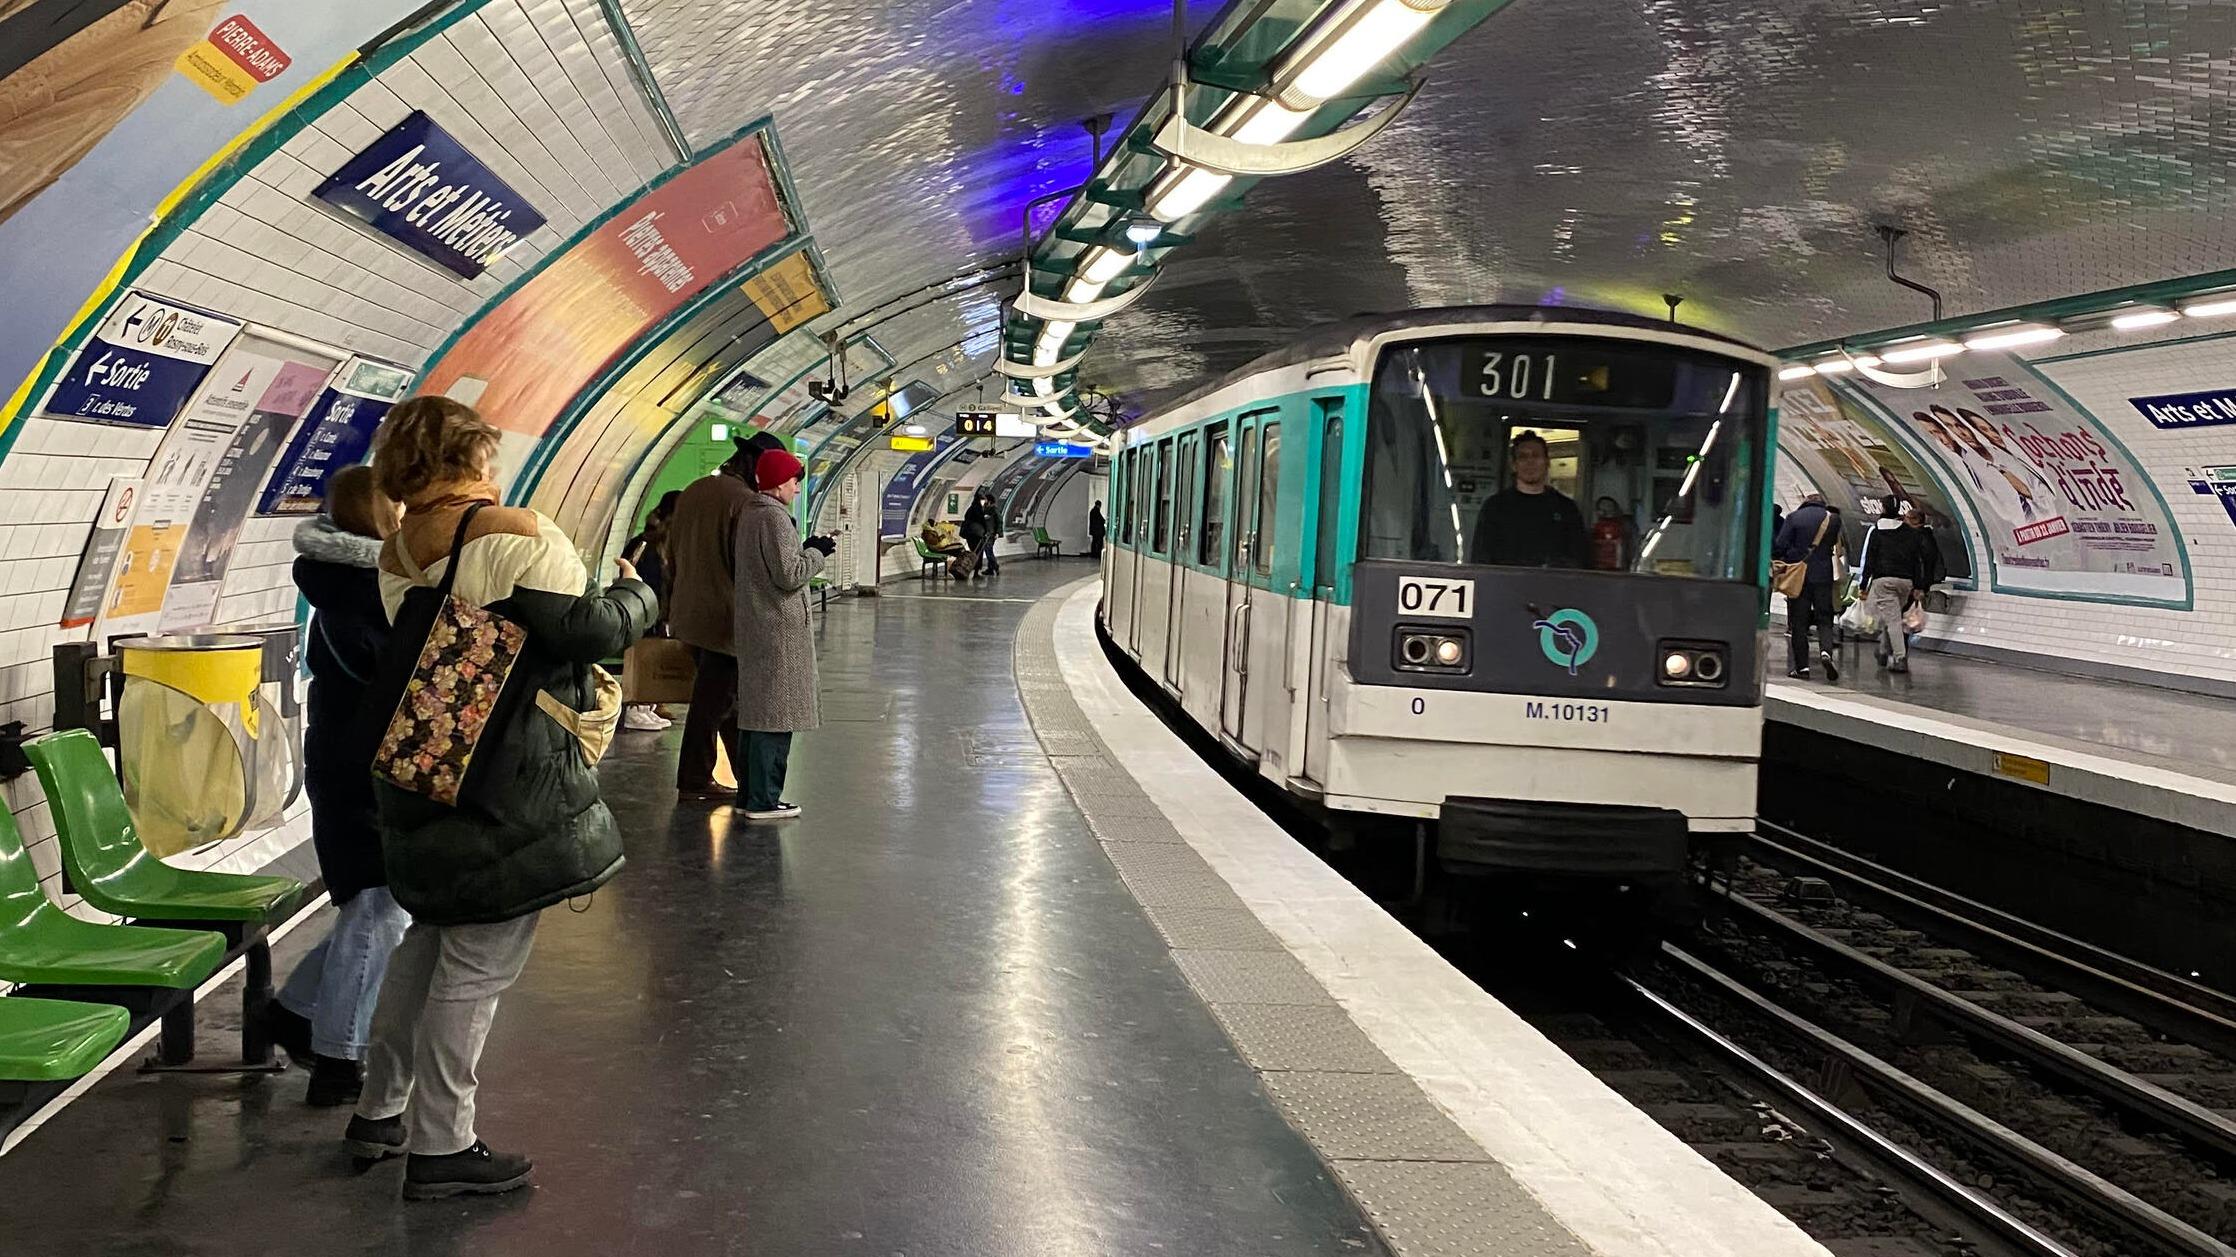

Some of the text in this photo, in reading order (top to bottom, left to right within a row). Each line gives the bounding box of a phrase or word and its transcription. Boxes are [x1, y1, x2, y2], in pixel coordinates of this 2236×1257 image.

[216, 20, 283, 77] PIERRE-ADAMS
[355, 144, 517, 267] Arts et Métiers
[618, 211, 695, 294] Pierres apparentes
[100, 358, 150, 391] Sortie
[1481, 352, 1554, 400] 301
[99, 399, 112, 415] des
[324, 400, 355, 424] Sortie
[2146, 403, 2197, 423] Arts
[2192, 400, 2224, 420] et
[1400, 582, 1466, 614] 071
[1411, 697, 1425, 715] 0
[1526, 701, 1609, 723] M.10131
